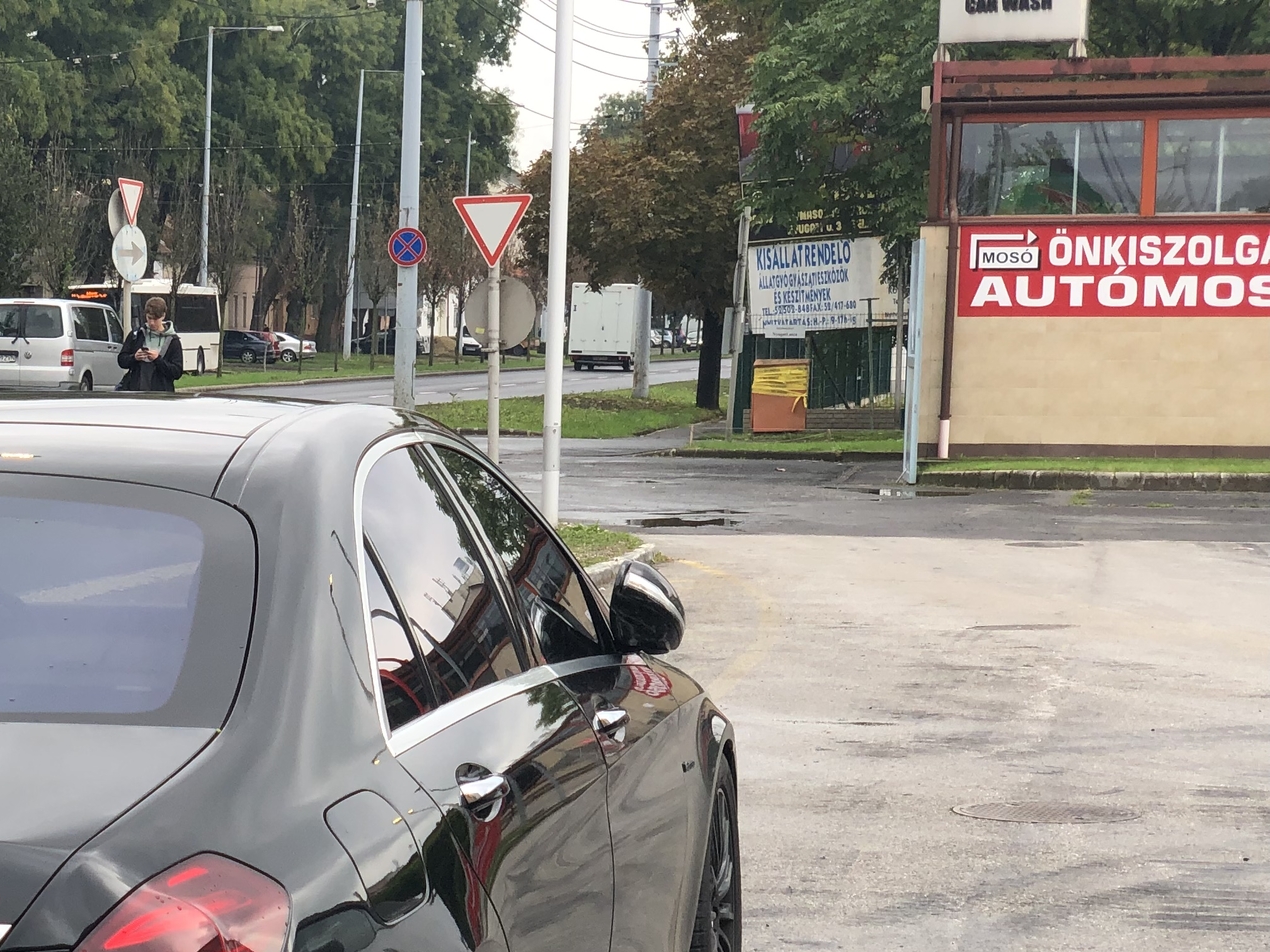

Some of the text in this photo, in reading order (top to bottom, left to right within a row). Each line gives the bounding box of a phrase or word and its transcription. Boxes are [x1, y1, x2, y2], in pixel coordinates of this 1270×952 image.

[982, 249, 1033, 264] MOSÓ
[970, 266, 1270, 307] AUTÓMOS
[774, 290, 781, 304] ÉS
